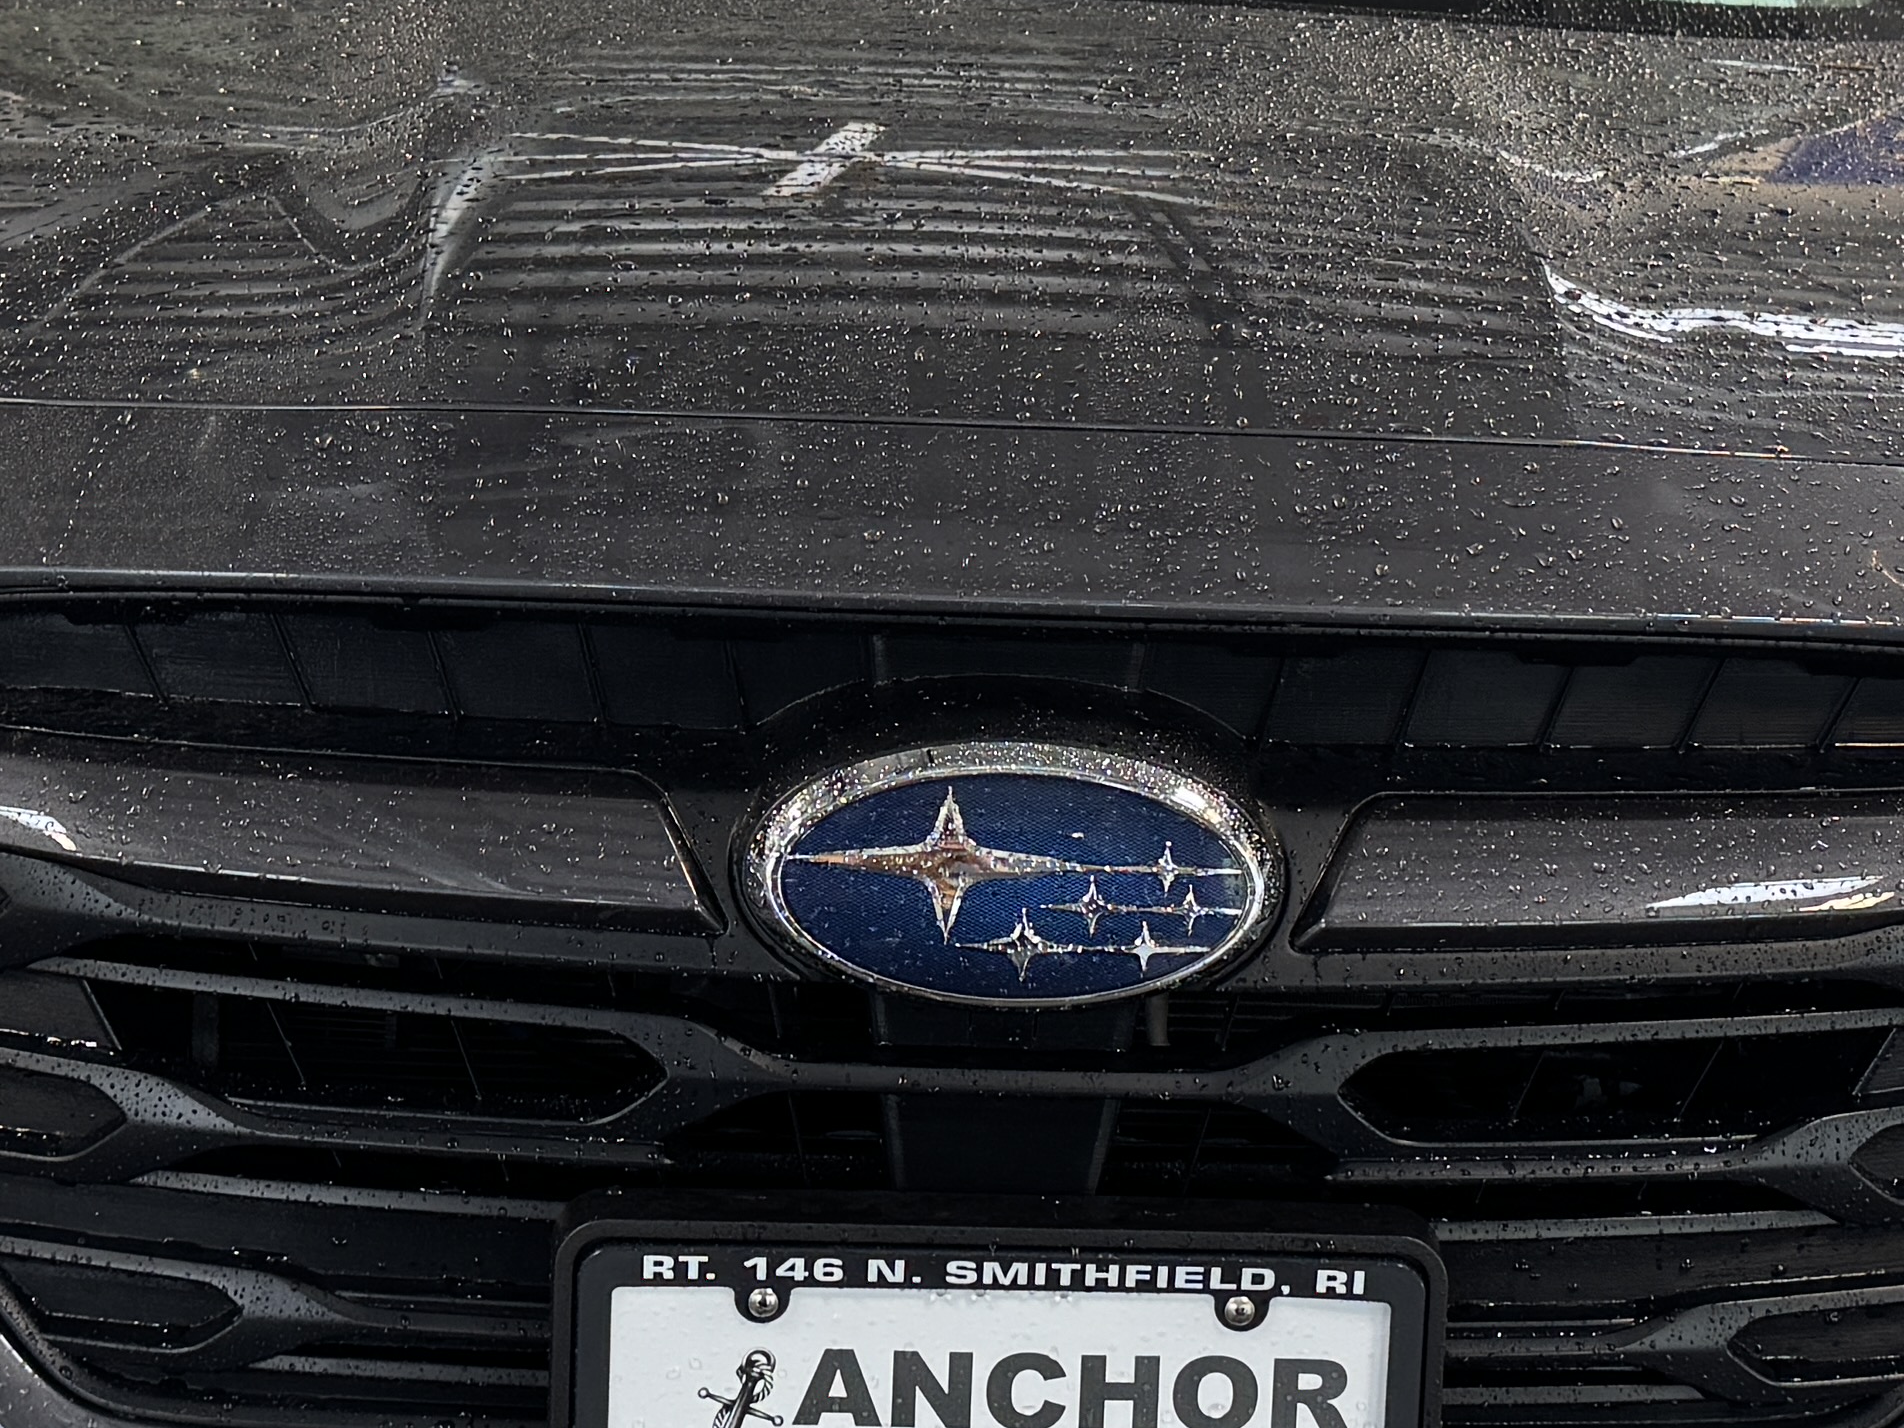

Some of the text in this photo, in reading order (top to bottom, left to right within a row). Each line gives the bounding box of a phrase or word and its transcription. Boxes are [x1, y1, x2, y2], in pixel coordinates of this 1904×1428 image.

[642, 1254, 1366, 1296] RT. 146 N. SMITHFIELD, RI
